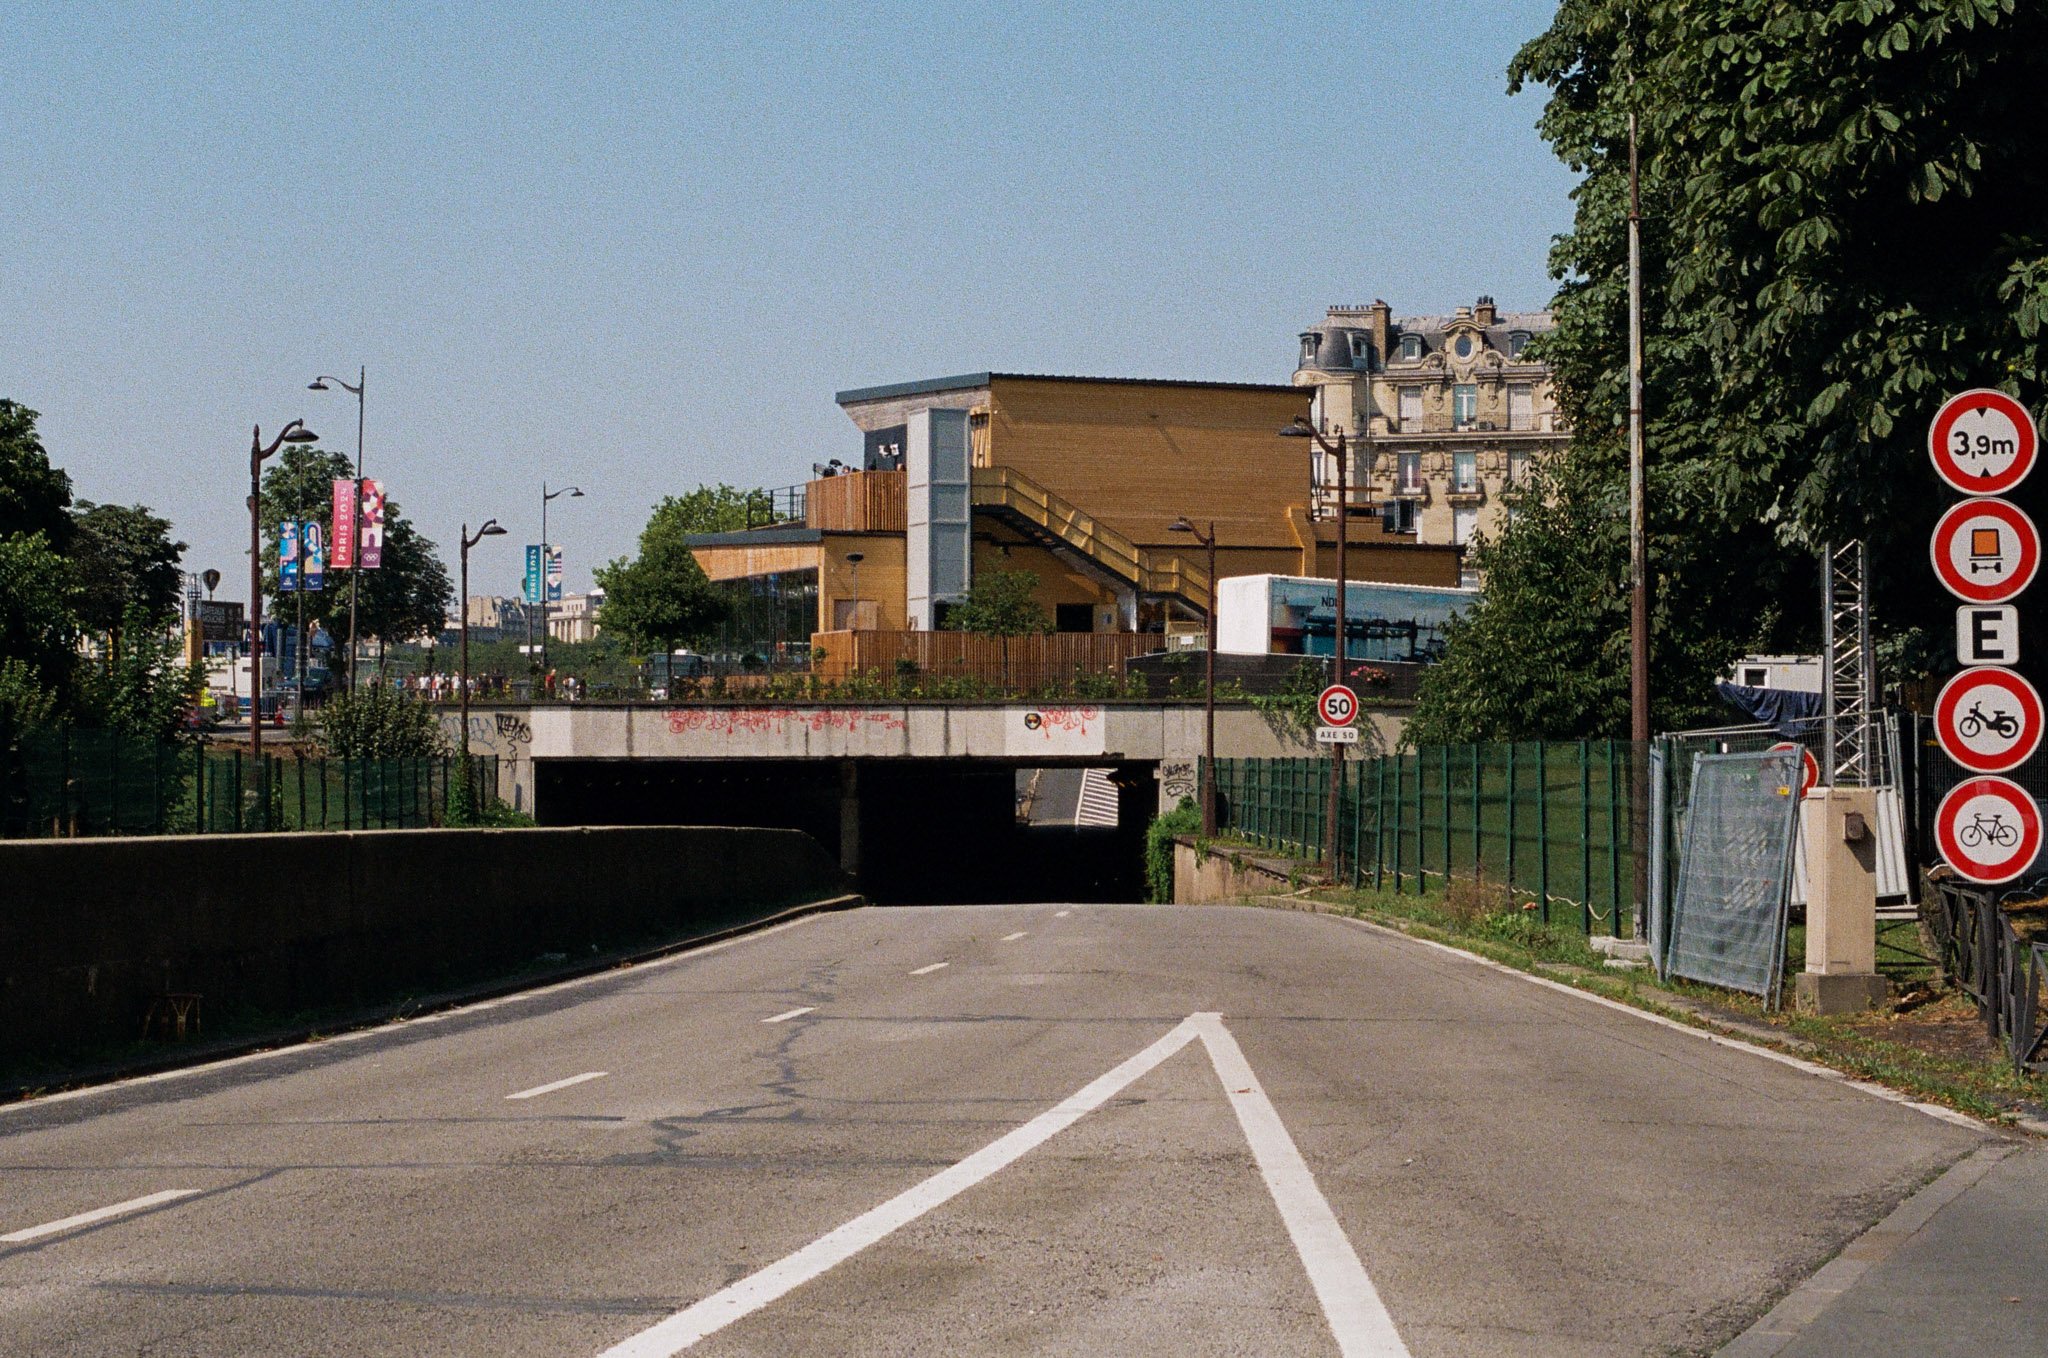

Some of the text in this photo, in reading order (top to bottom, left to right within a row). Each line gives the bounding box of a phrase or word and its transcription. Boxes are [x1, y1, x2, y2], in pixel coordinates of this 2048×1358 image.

[1953, 431, 2014, 459] 3,9m
[337, 487, 349, 561] PARIS 2024
[1972, 610, 2004, 660] E
[1327, 699, 1350, 715] 50
[1320, 731, 1337, 739] AXE
